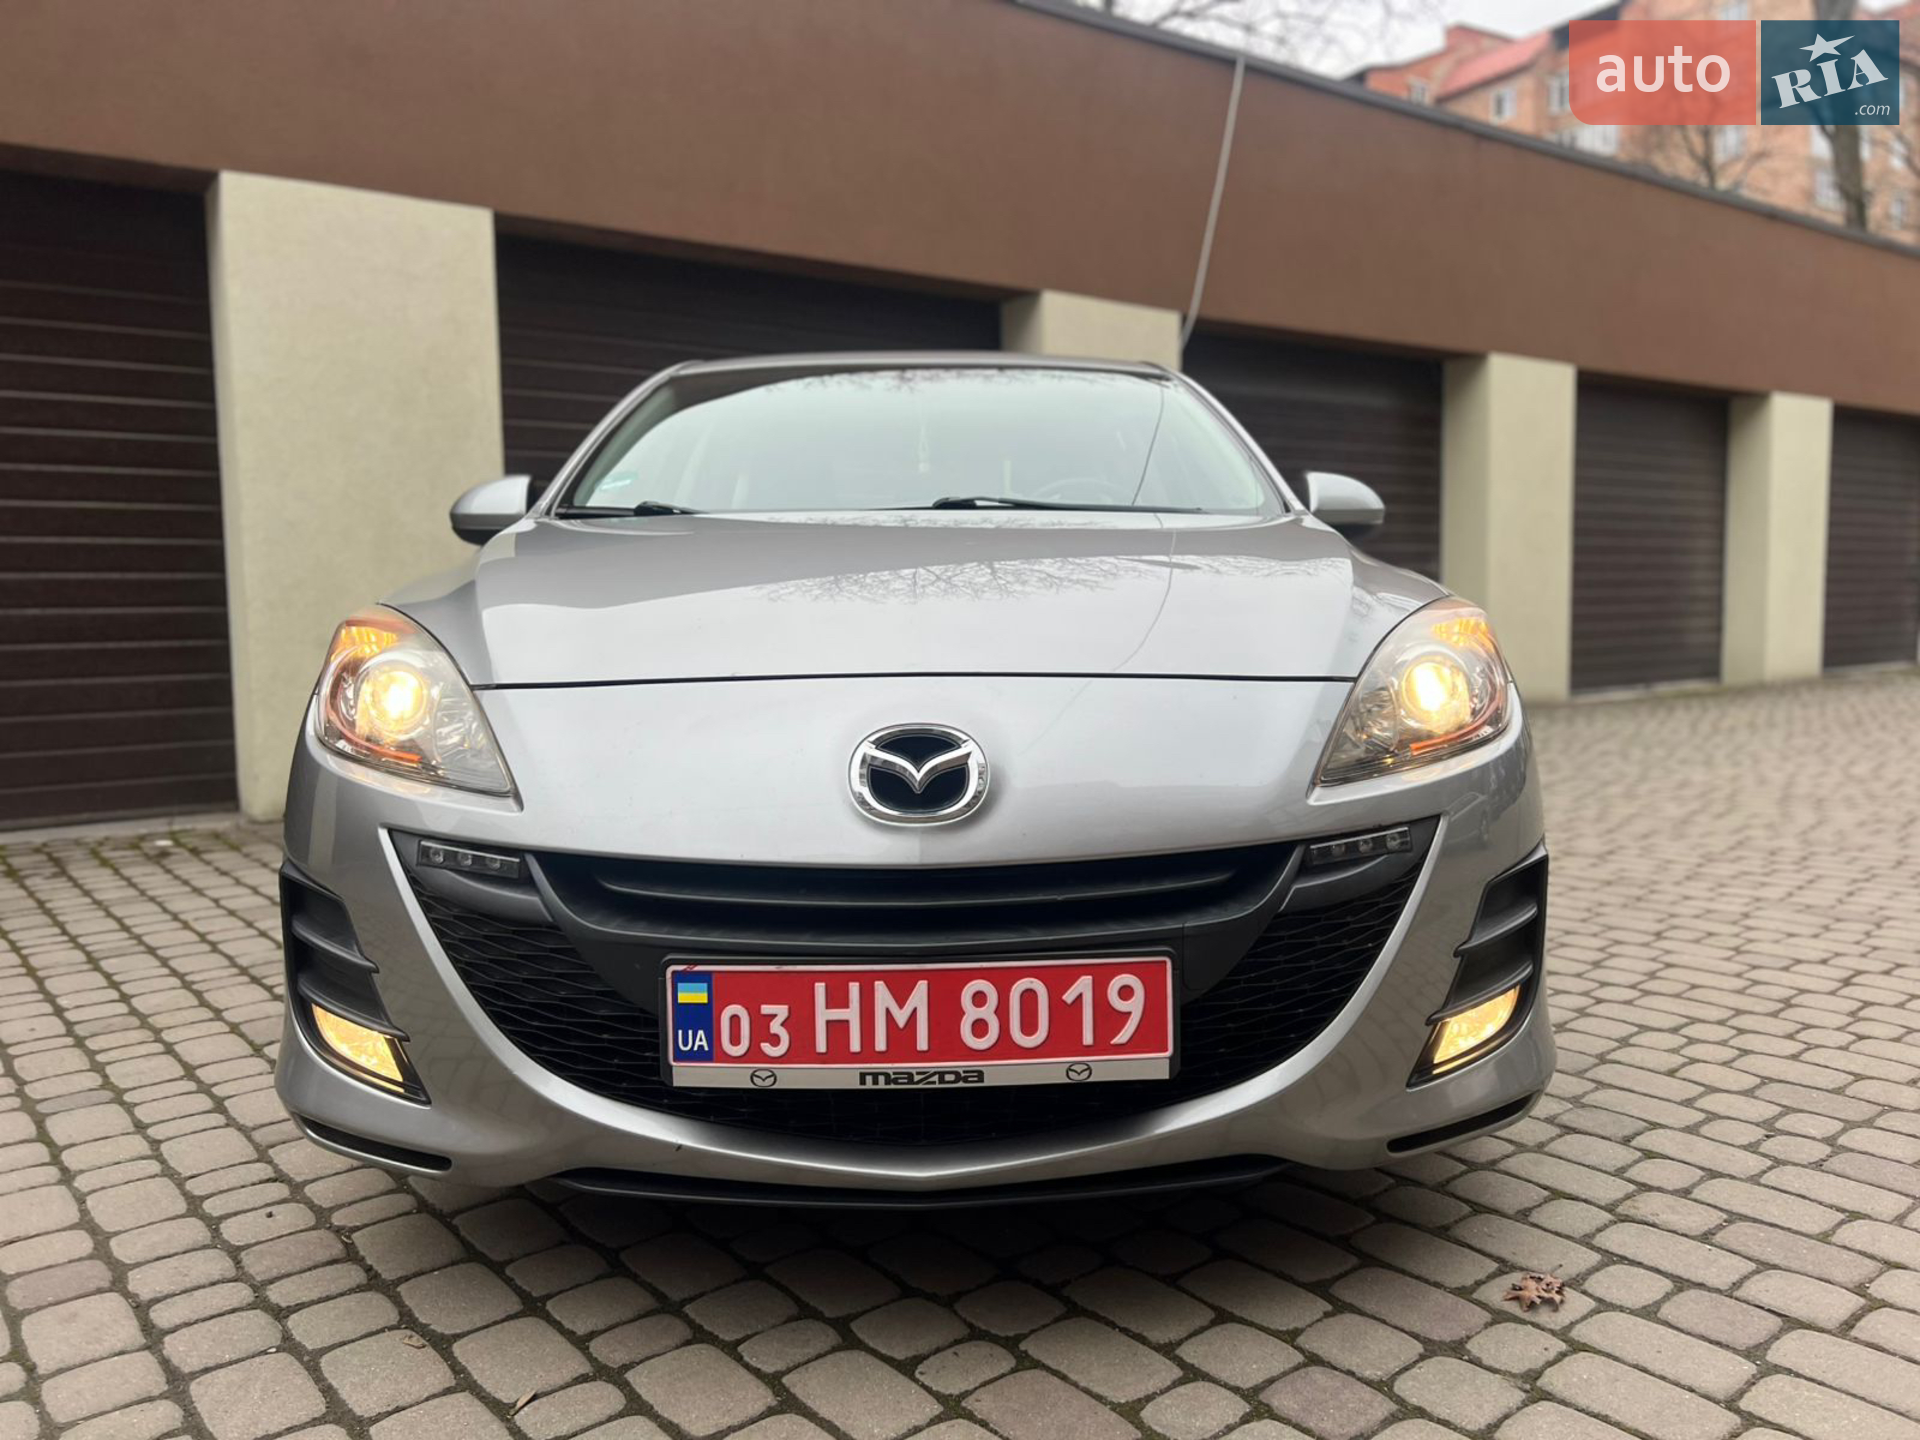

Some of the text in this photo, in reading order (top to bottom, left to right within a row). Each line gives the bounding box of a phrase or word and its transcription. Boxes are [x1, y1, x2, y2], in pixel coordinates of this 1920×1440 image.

[720, 974, 1145, 1057] 03 HM 8019
[678, 1029, 708, 1050] UA
[859, 1070, 985, 1086] mazda
